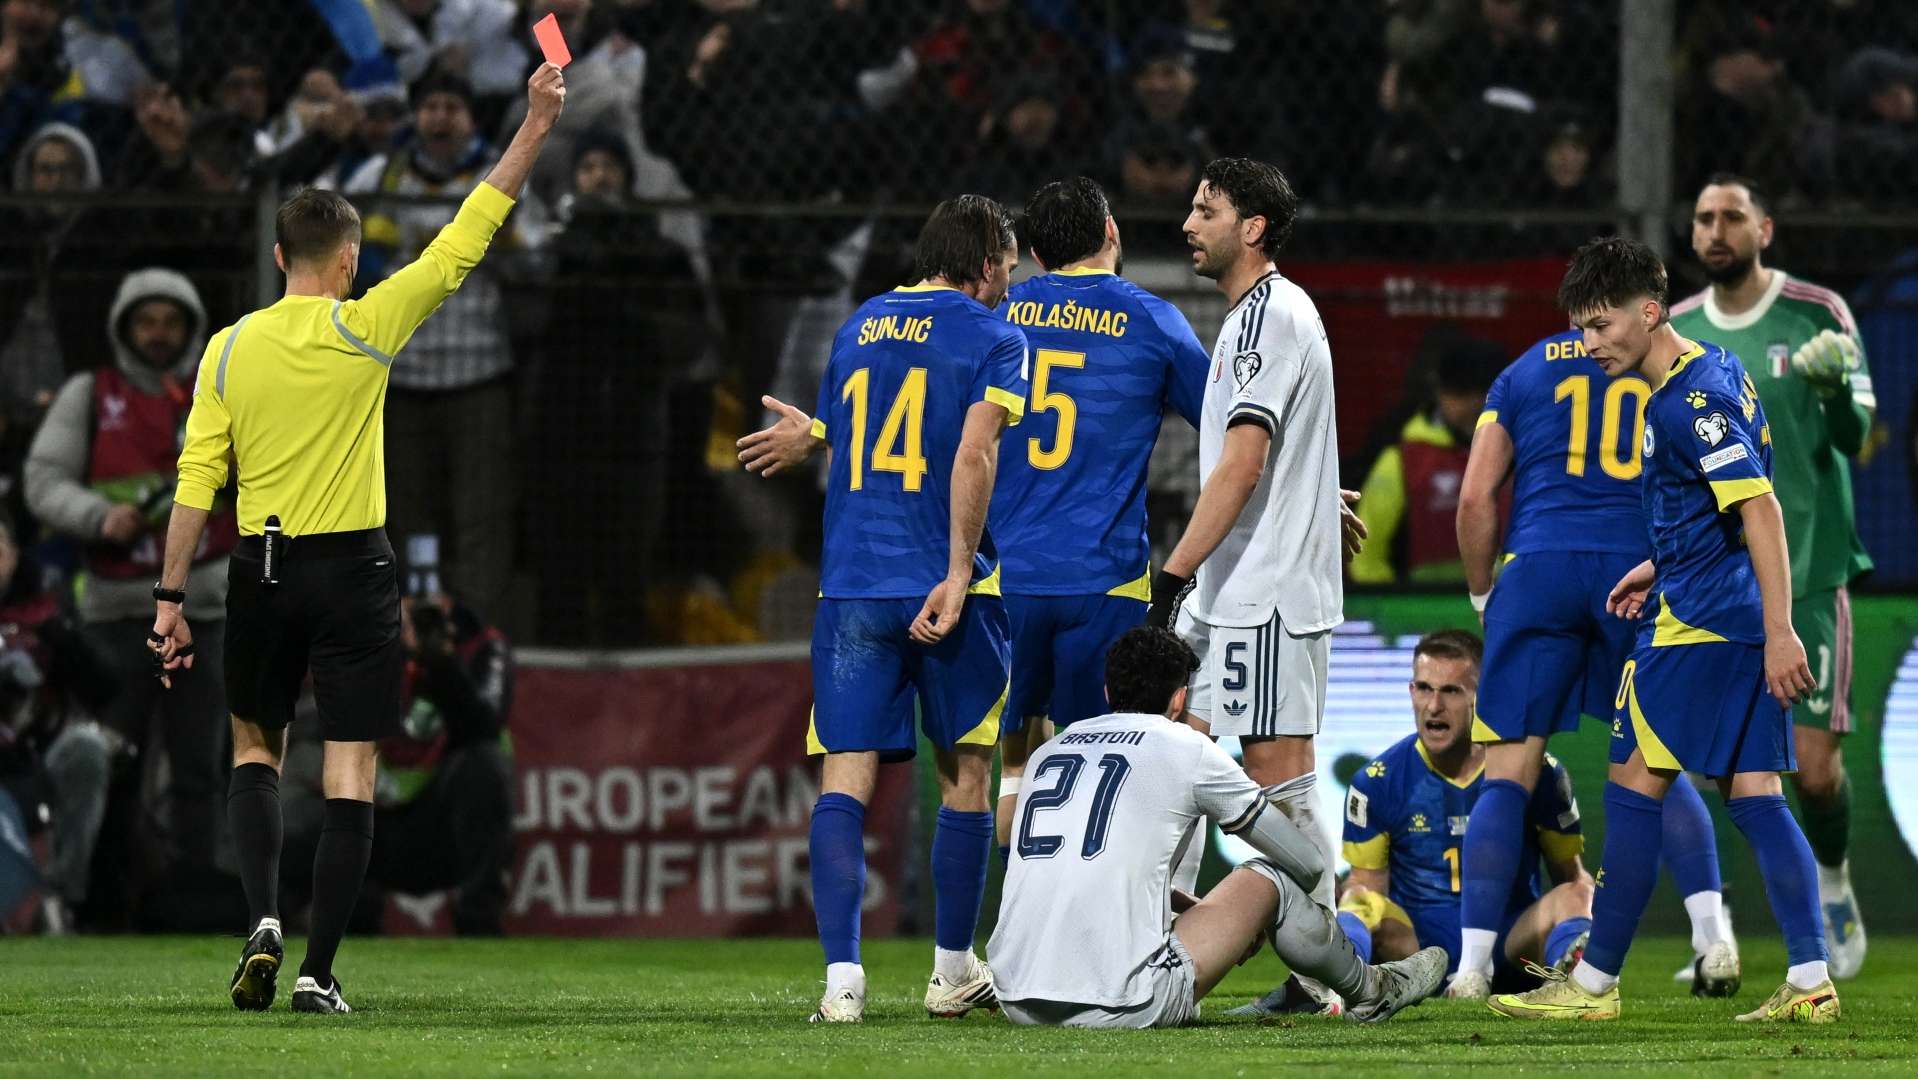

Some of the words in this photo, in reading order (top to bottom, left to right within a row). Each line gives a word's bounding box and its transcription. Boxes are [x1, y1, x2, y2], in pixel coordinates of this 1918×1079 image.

[858, 316, 933, 346] ŠUNJIĆ
[1007, 300, 1128, 337] KOLAŠINAC
[842, 367, 928, 492] 14
[1028, 348, 1086, 470] 5
[1554, 374, 1652, 480] 10
[1222, 642, 1248, 691] 5
[1818, 644, 1830, 691] 1
[1059, 731, 1146, 746] BASTONI
[1017, 753, 1132, 861] 21
